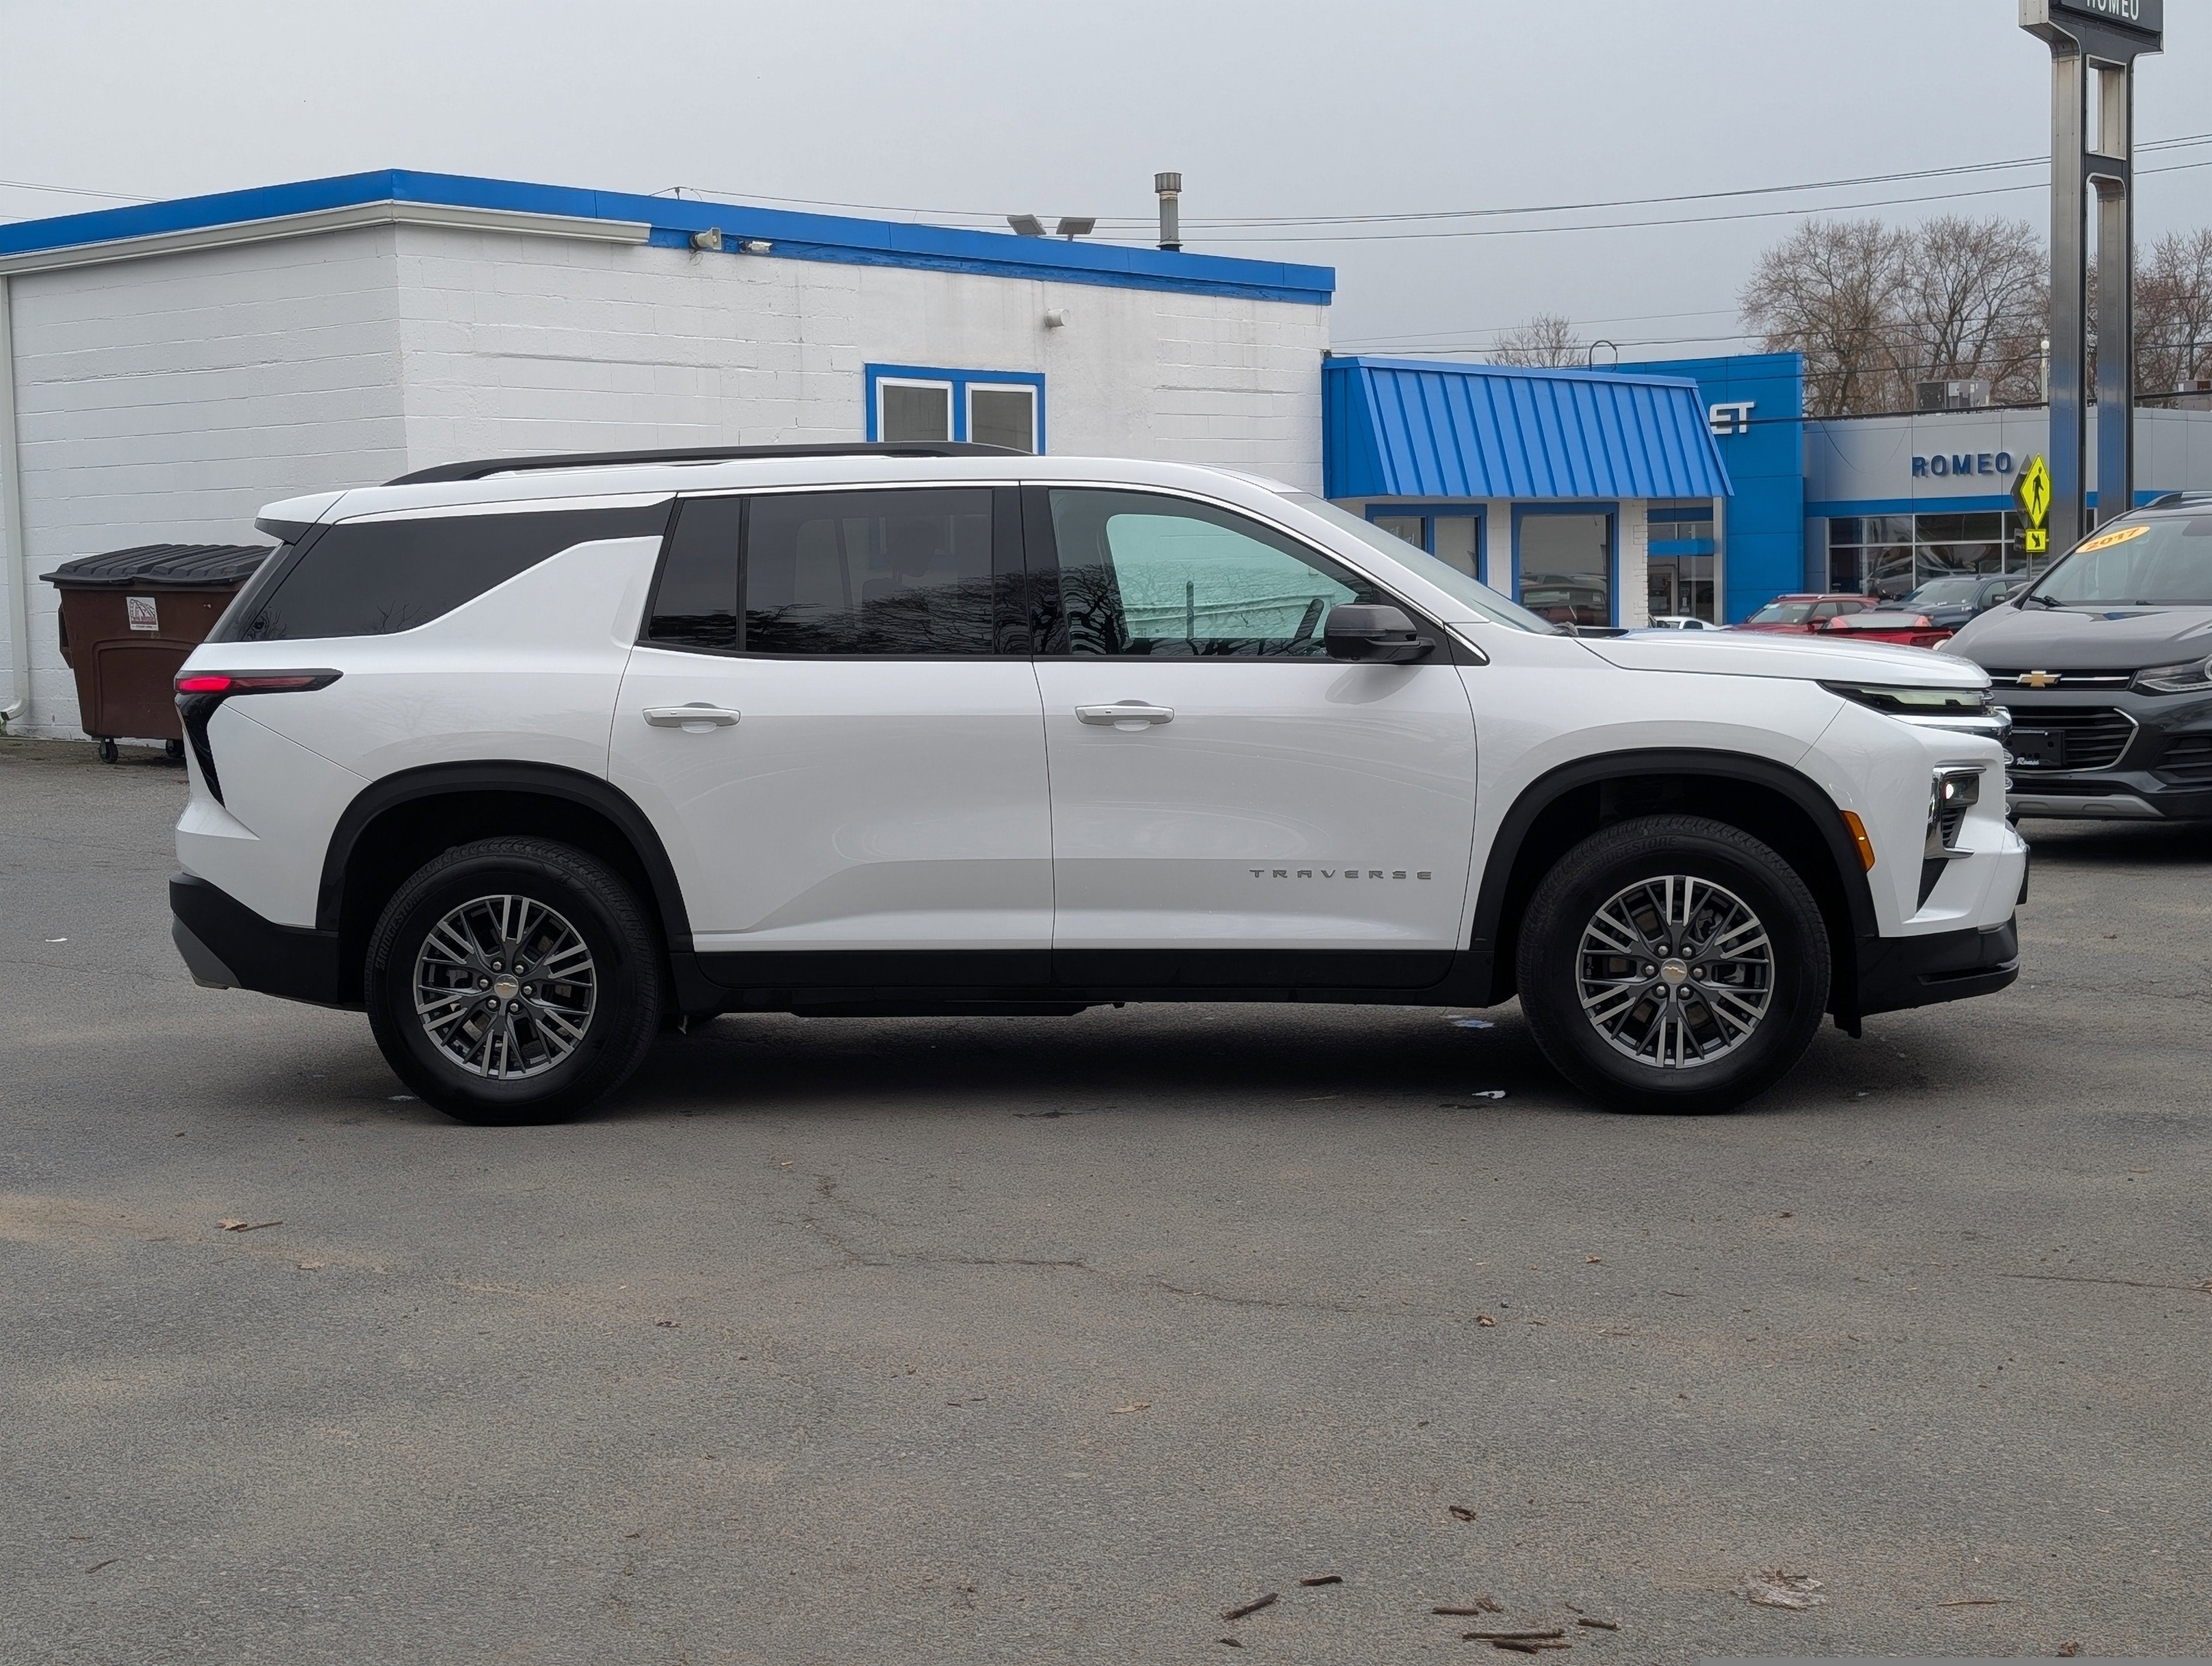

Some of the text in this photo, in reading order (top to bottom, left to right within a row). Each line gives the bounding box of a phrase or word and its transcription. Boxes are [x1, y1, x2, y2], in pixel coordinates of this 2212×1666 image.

[1912, 452, 2012, 477] ROMEO
[2085, 528, 2139, 551] 2017
[1249, 869, 1432, 880] TRAVERSE
